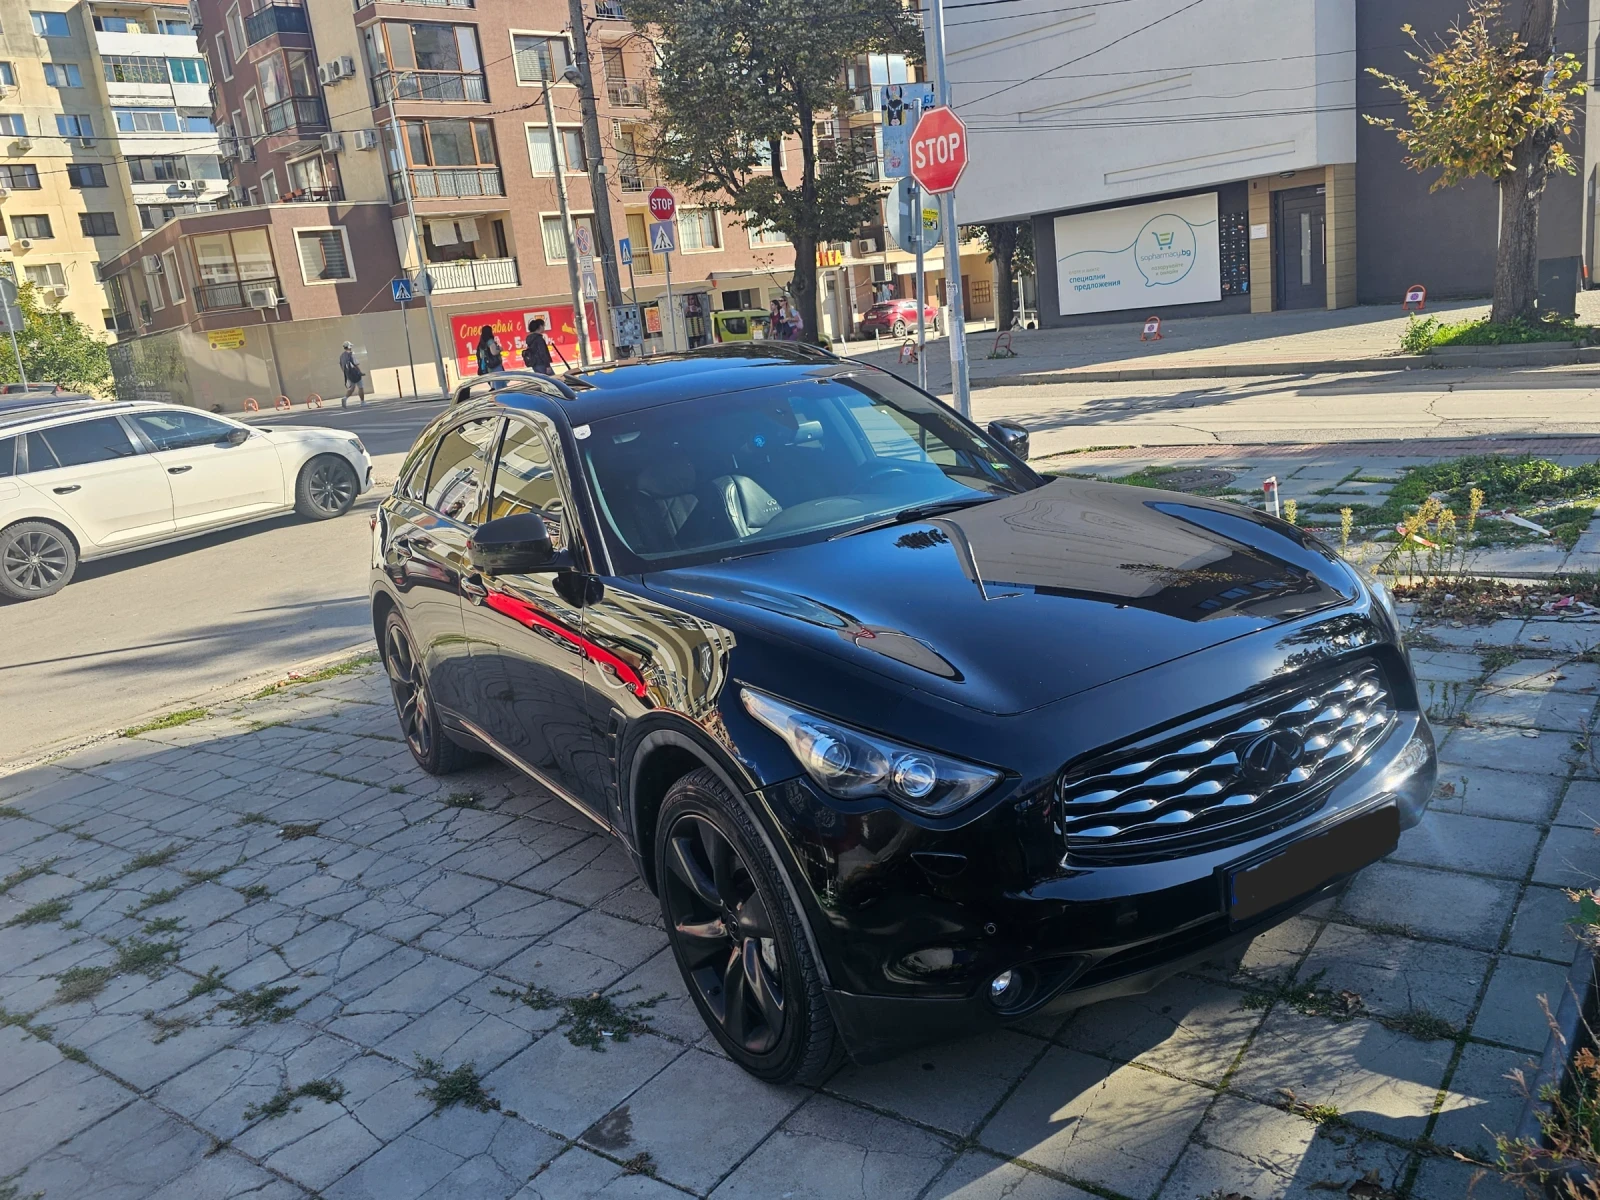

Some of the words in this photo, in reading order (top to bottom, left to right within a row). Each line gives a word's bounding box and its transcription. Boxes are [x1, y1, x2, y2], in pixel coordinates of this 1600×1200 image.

[915, 132, 961, 169] STOP
[651, 197, 673, 210] STOP
[1140, 249, 1191, 261] sopharmacy.bg
[1069, 273, 1106, 284] специални
[1074, 279, 1121, 292] предложения
